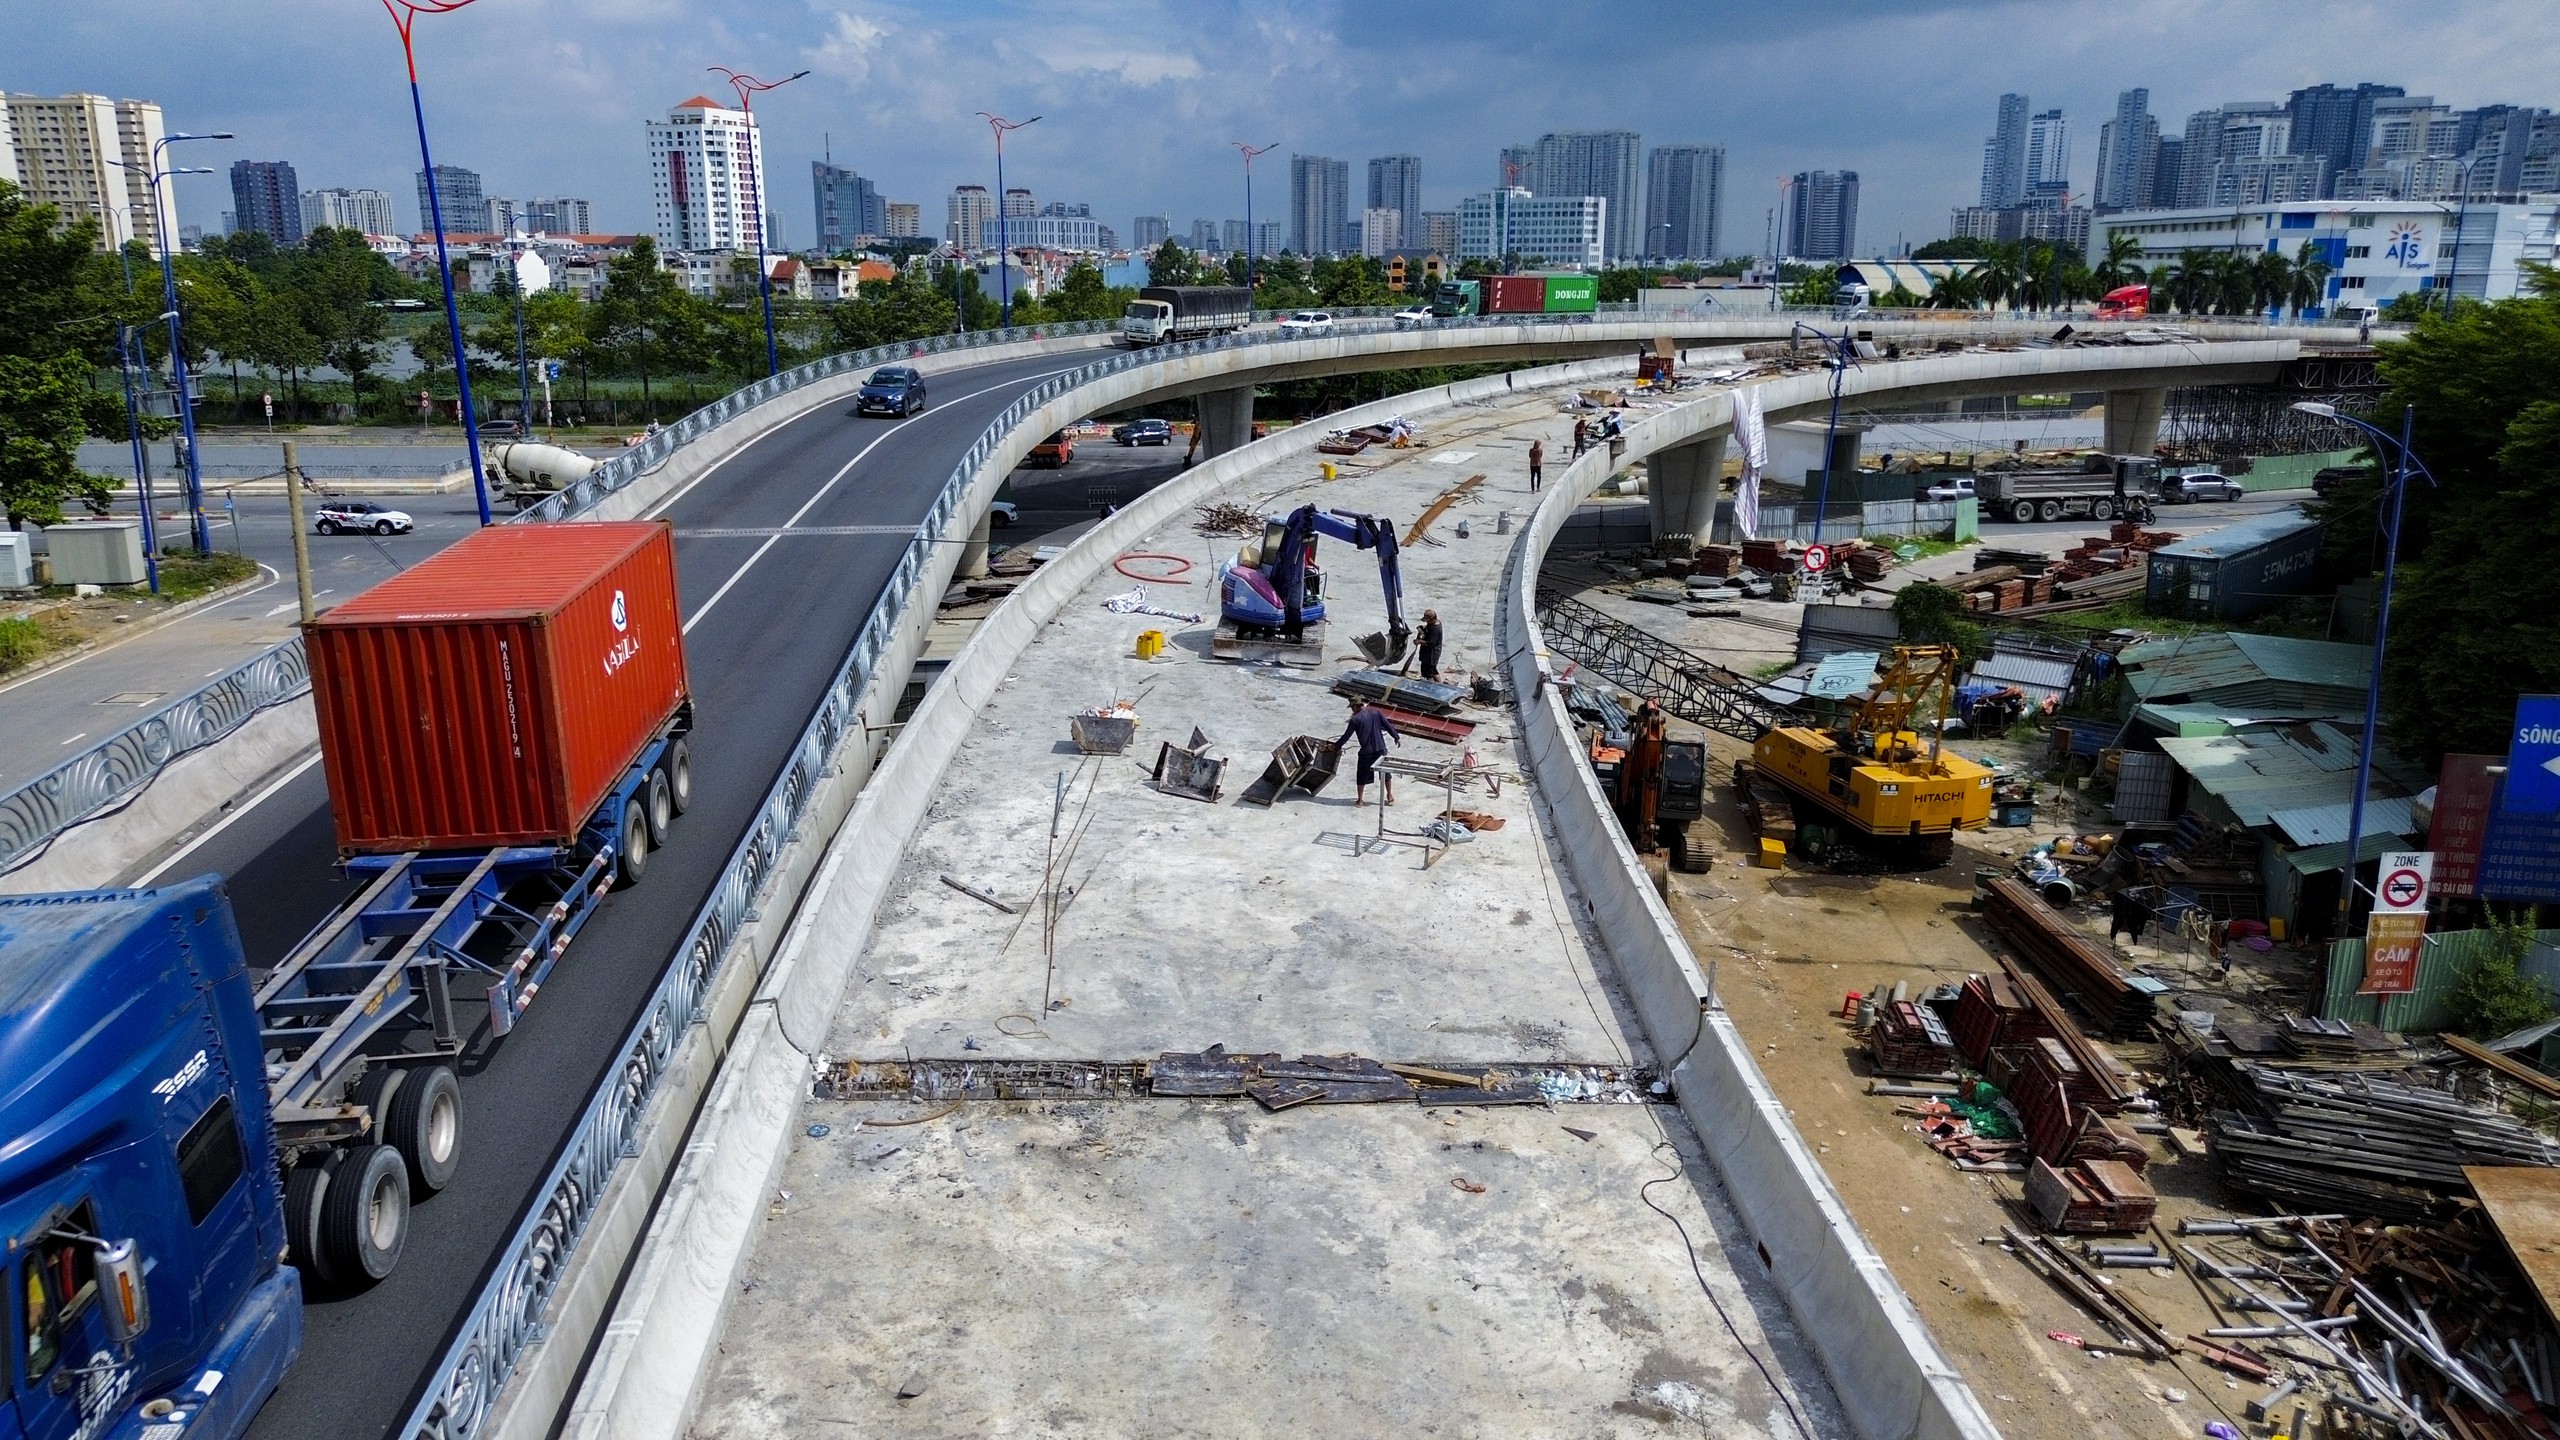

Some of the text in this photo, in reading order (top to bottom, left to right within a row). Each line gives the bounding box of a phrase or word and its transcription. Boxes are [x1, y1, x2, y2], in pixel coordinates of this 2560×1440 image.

[1555, 290, 1590, 299] DONGJIN
[2261, 548, 2315, 583] SENATOR
[500, 640, 511, 681] MAGU
[506, 684, 518, 743] 250219
[2519, 724, 2560, 744] SÔNG
[1914, 791, 1964, 803] HITACHI
[2394, 856, 2420, 867] ZONE
